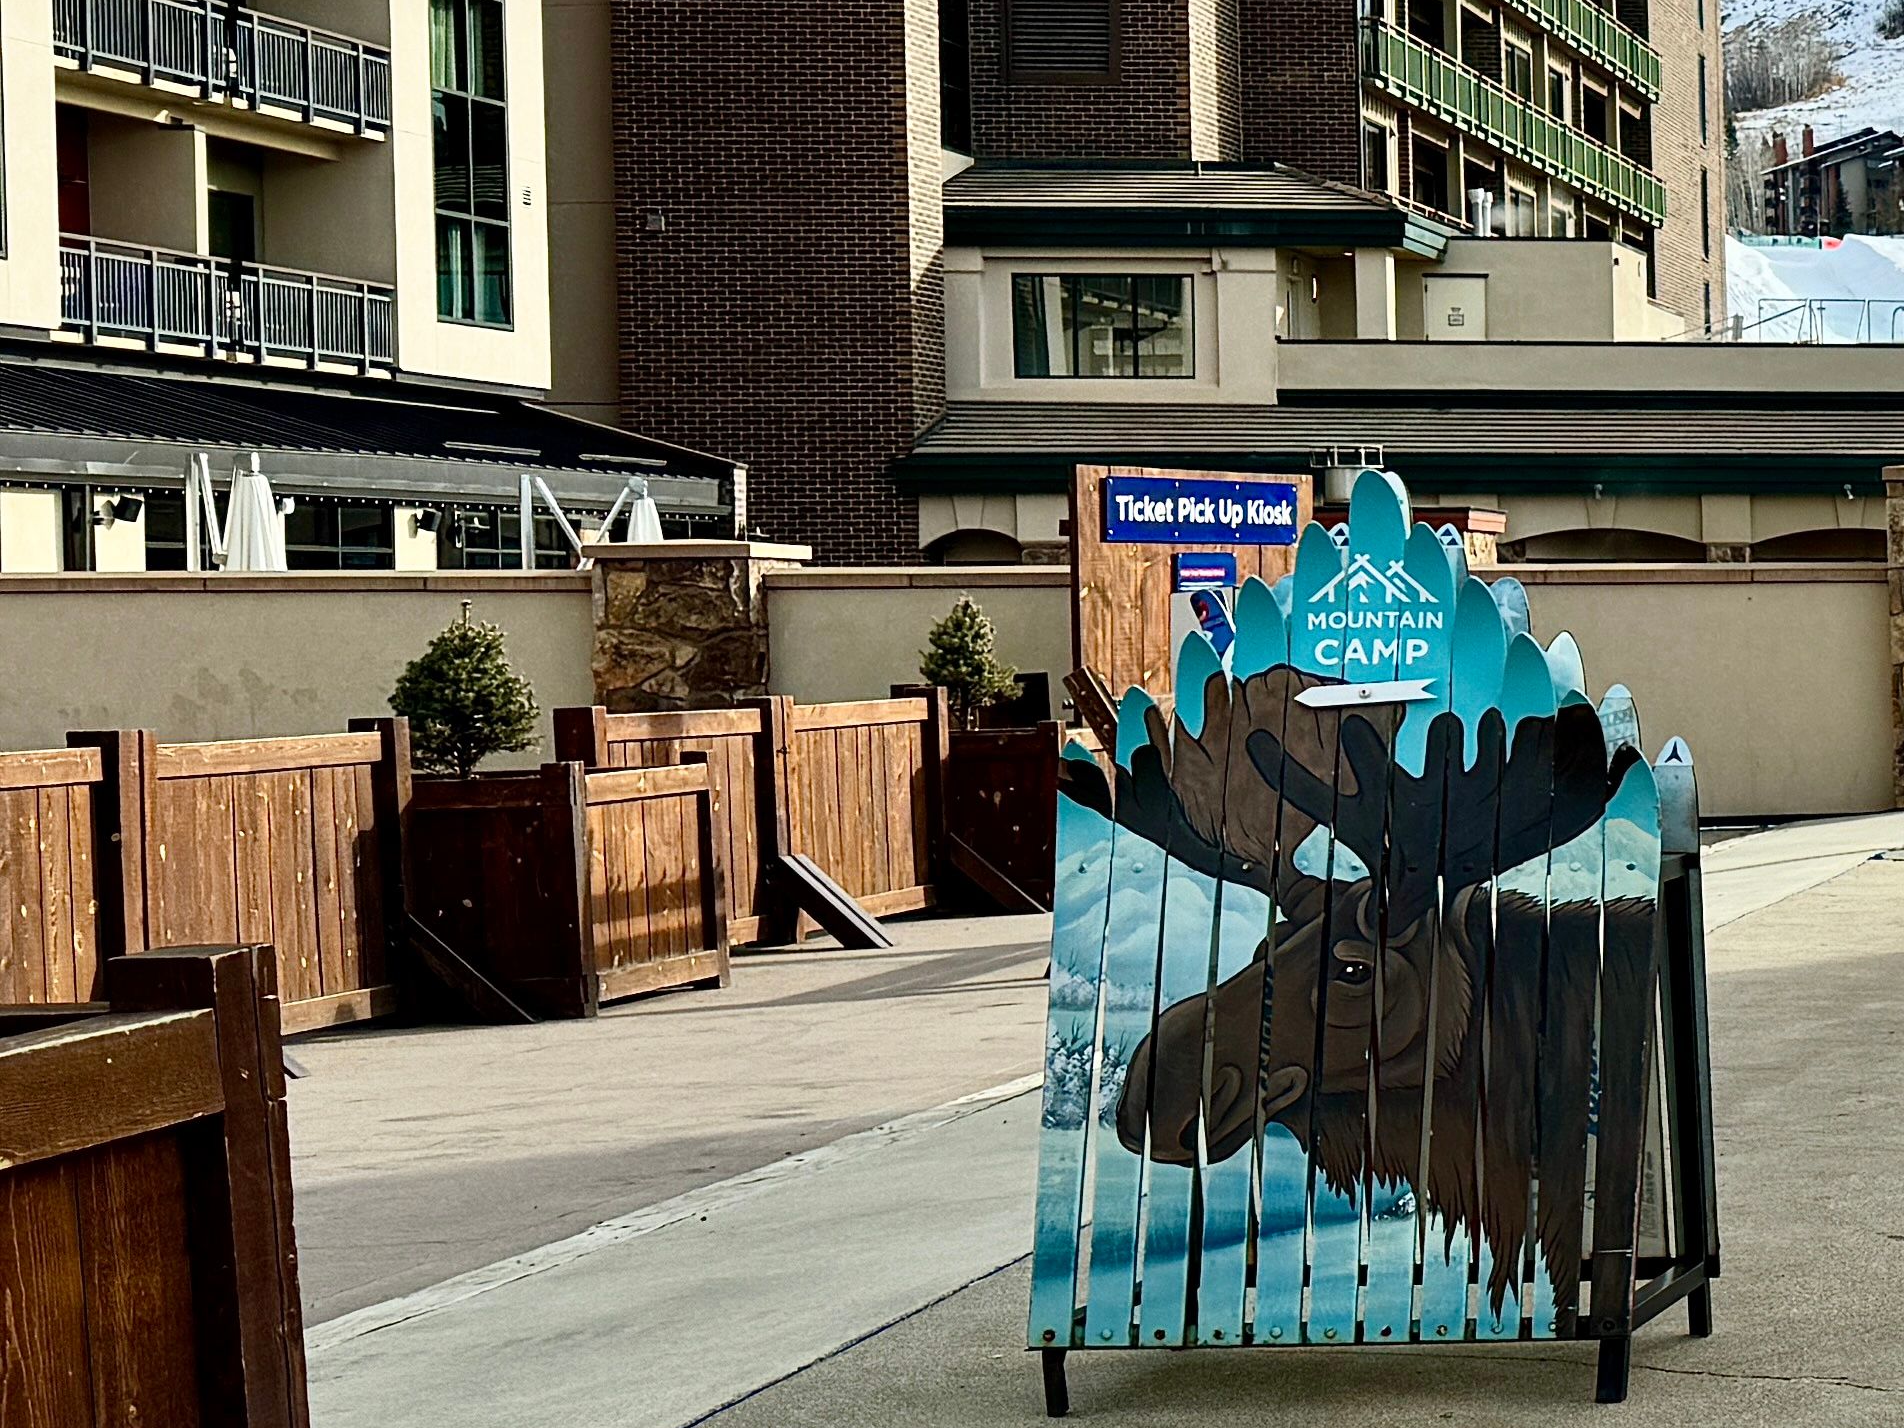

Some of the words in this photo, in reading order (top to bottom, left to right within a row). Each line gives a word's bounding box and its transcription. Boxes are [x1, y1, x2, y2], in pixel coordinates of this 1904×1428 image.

[1115, 495, 1173, 522] Ticket
[1177, 497, 1215, 523] Pick
[1218, 499, 1243, 528] Up
[1247, 500, 1292, 525] Kiosk
[1307, 611, 1443, 630] MOUNTAIN
[1314, 638, 1429, 665] CAMP
